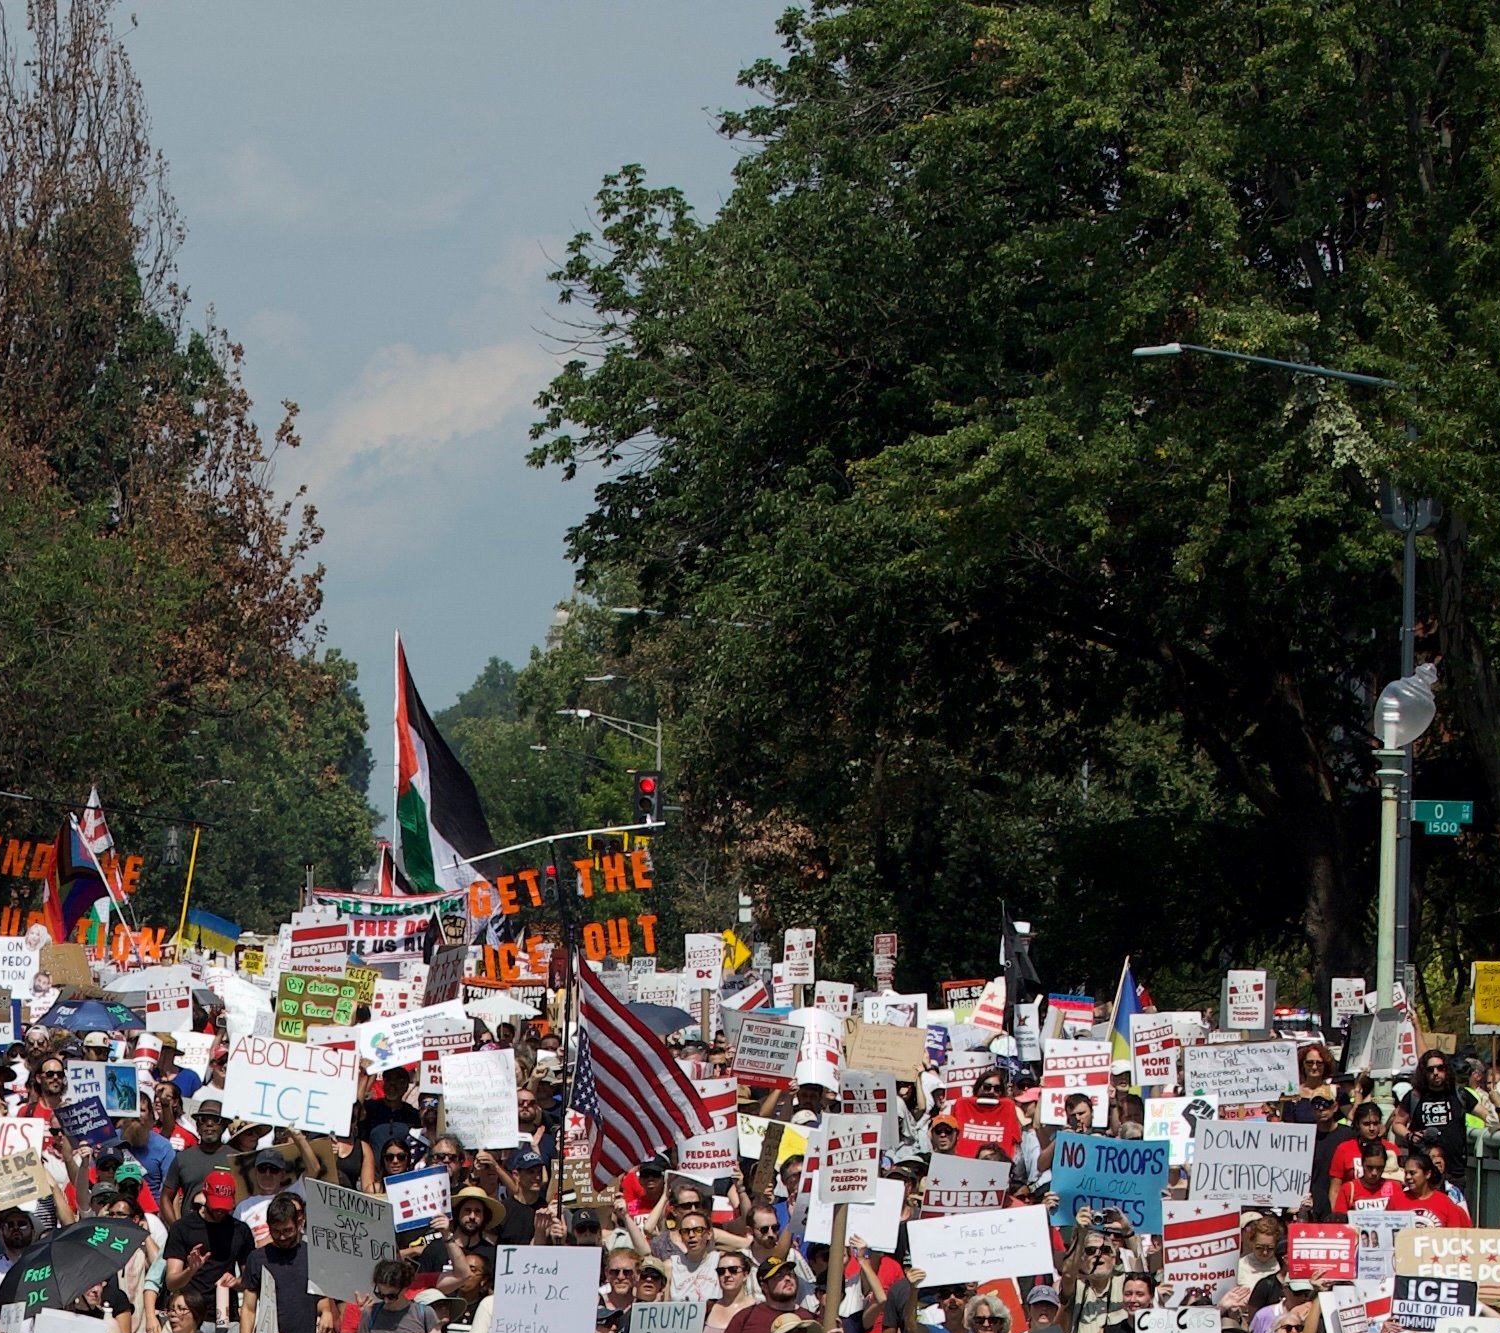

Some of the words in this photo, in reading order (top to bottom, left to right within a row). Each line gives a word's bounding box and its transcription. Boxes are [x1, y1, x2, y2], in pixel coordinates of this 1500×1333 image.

[229, 1038, 357, 1080] ABOLISH
[253, 1081, 326, 1126] ICE
[1204, 1130, 1260, 1153] DOWN
[1269, 1134, 1309, 1153] WITH
[1060, 1141, 1085, 1169] NO
[1095, 1147, 1165, 1174] TROOPS
[315, 1183, 386, 1221] VERMONT
[333, 1214, 369, 1239] SAYS
[311, 1227, 363, 1257] FREE
[500, 1248, 518, 1276] I
[638, 1305, 697, 1330] TRUMP
